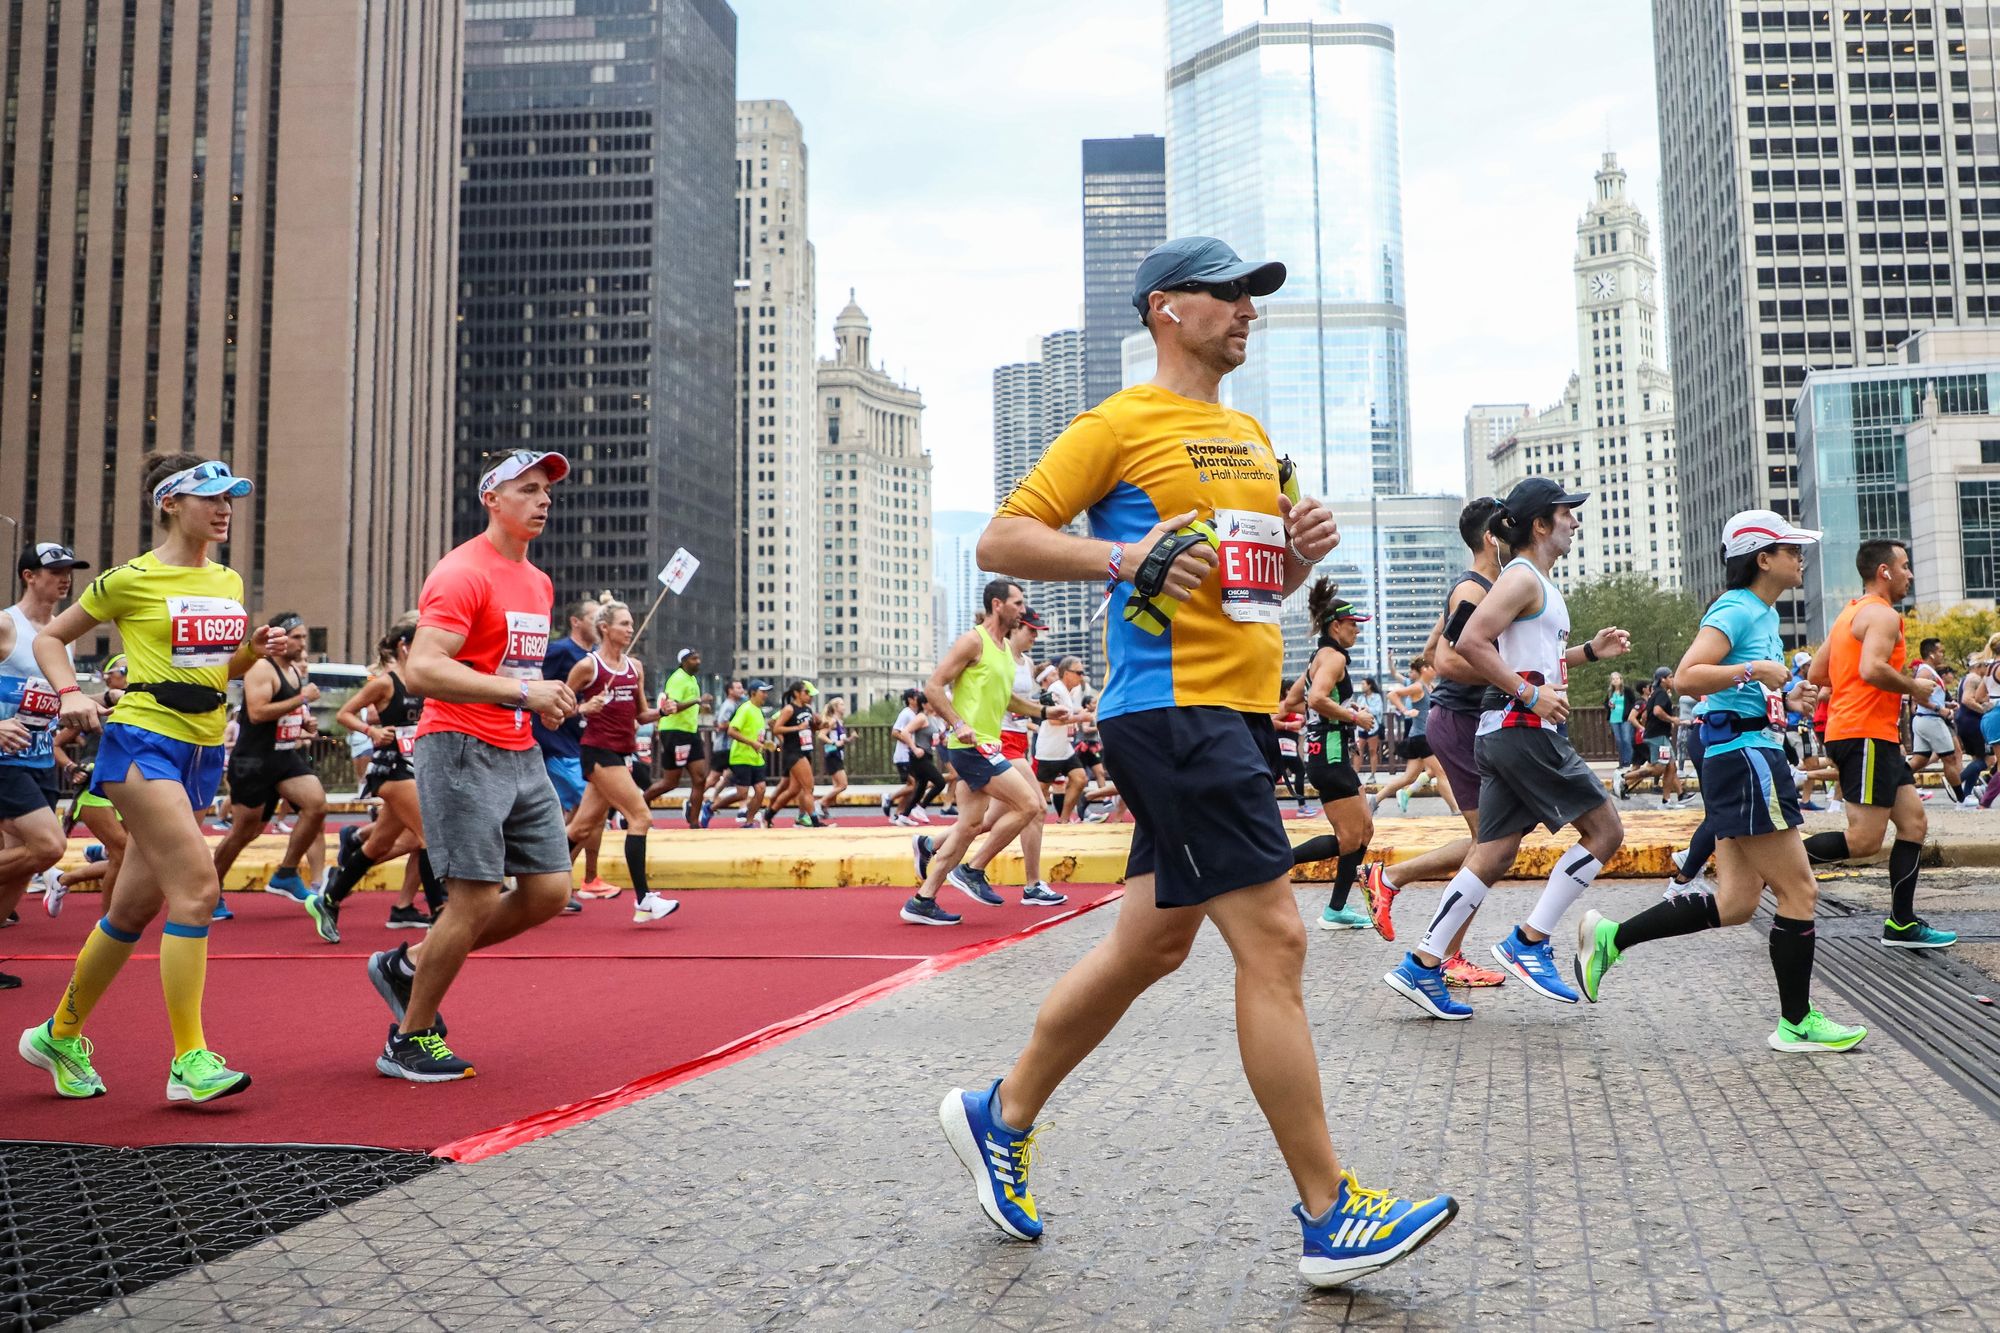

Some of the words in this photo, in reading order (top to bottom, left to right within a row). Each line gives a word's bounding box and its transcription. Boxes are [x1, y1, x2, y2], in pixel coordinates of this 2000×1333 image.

[1186, 444, 1249, 456] Naperville
[1191, 456, 1256, 469] Marathon
[1200, 471, 1209, 482] &
[1210, 470, 1231, 480] Half
[1233, 470, 1275, 480] Marathon
[1225, 546, 1242, 580] E
[1245, 547, 1284, 586] 11716
[177, 619, 189, 642] E
[194, 618, 245, 642] 16928
[510, 633, 518, 656] E
[520, 634, 547, 658] 16928
[24, 691, 34, 708] E
